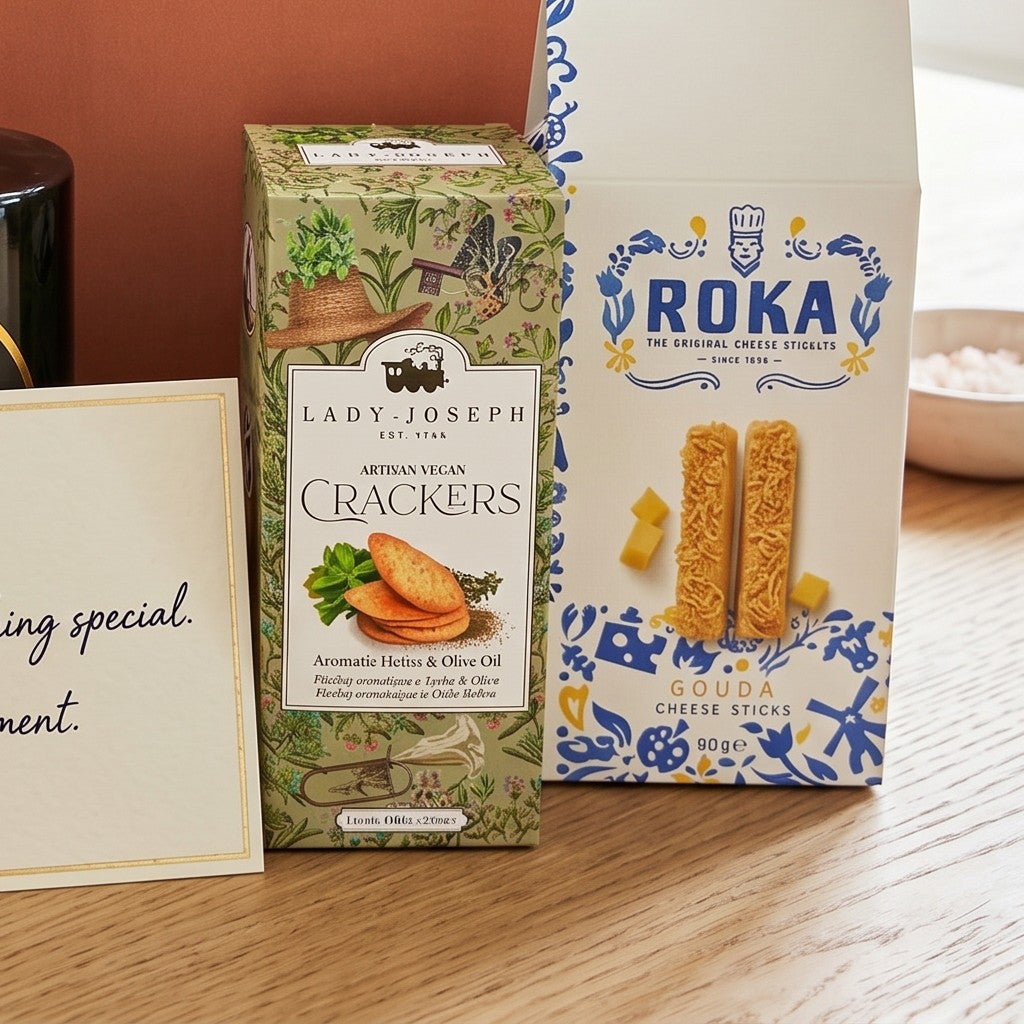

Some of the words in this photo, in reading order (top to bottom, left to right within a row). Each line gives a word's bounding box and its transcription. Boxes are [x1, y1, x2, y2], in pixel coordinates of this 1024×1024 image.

[647, 279, 837, 335] ROKA
[647, 338, 668, 348] THE
[734, 340, 778, 350] CHEESE
[711, 356, 740, 364] SINCE
[379, 431, 408, 439] EST.
[420, 464, 466, 476] VEGAN
[301, 478, 521, 525] CRACKERS
[70, 581, 194, 656] special.
[426, 655, 438, 668] &
[441, 654, 477, 668] Olive
[480, 654, 501, 667] Oil
[458, 675, 468, 686] &
[670, 679, 775, 699] GOUDA
[655, 702, 720, 716] CHEESE
[731, 703, 792, 717] STICKS
